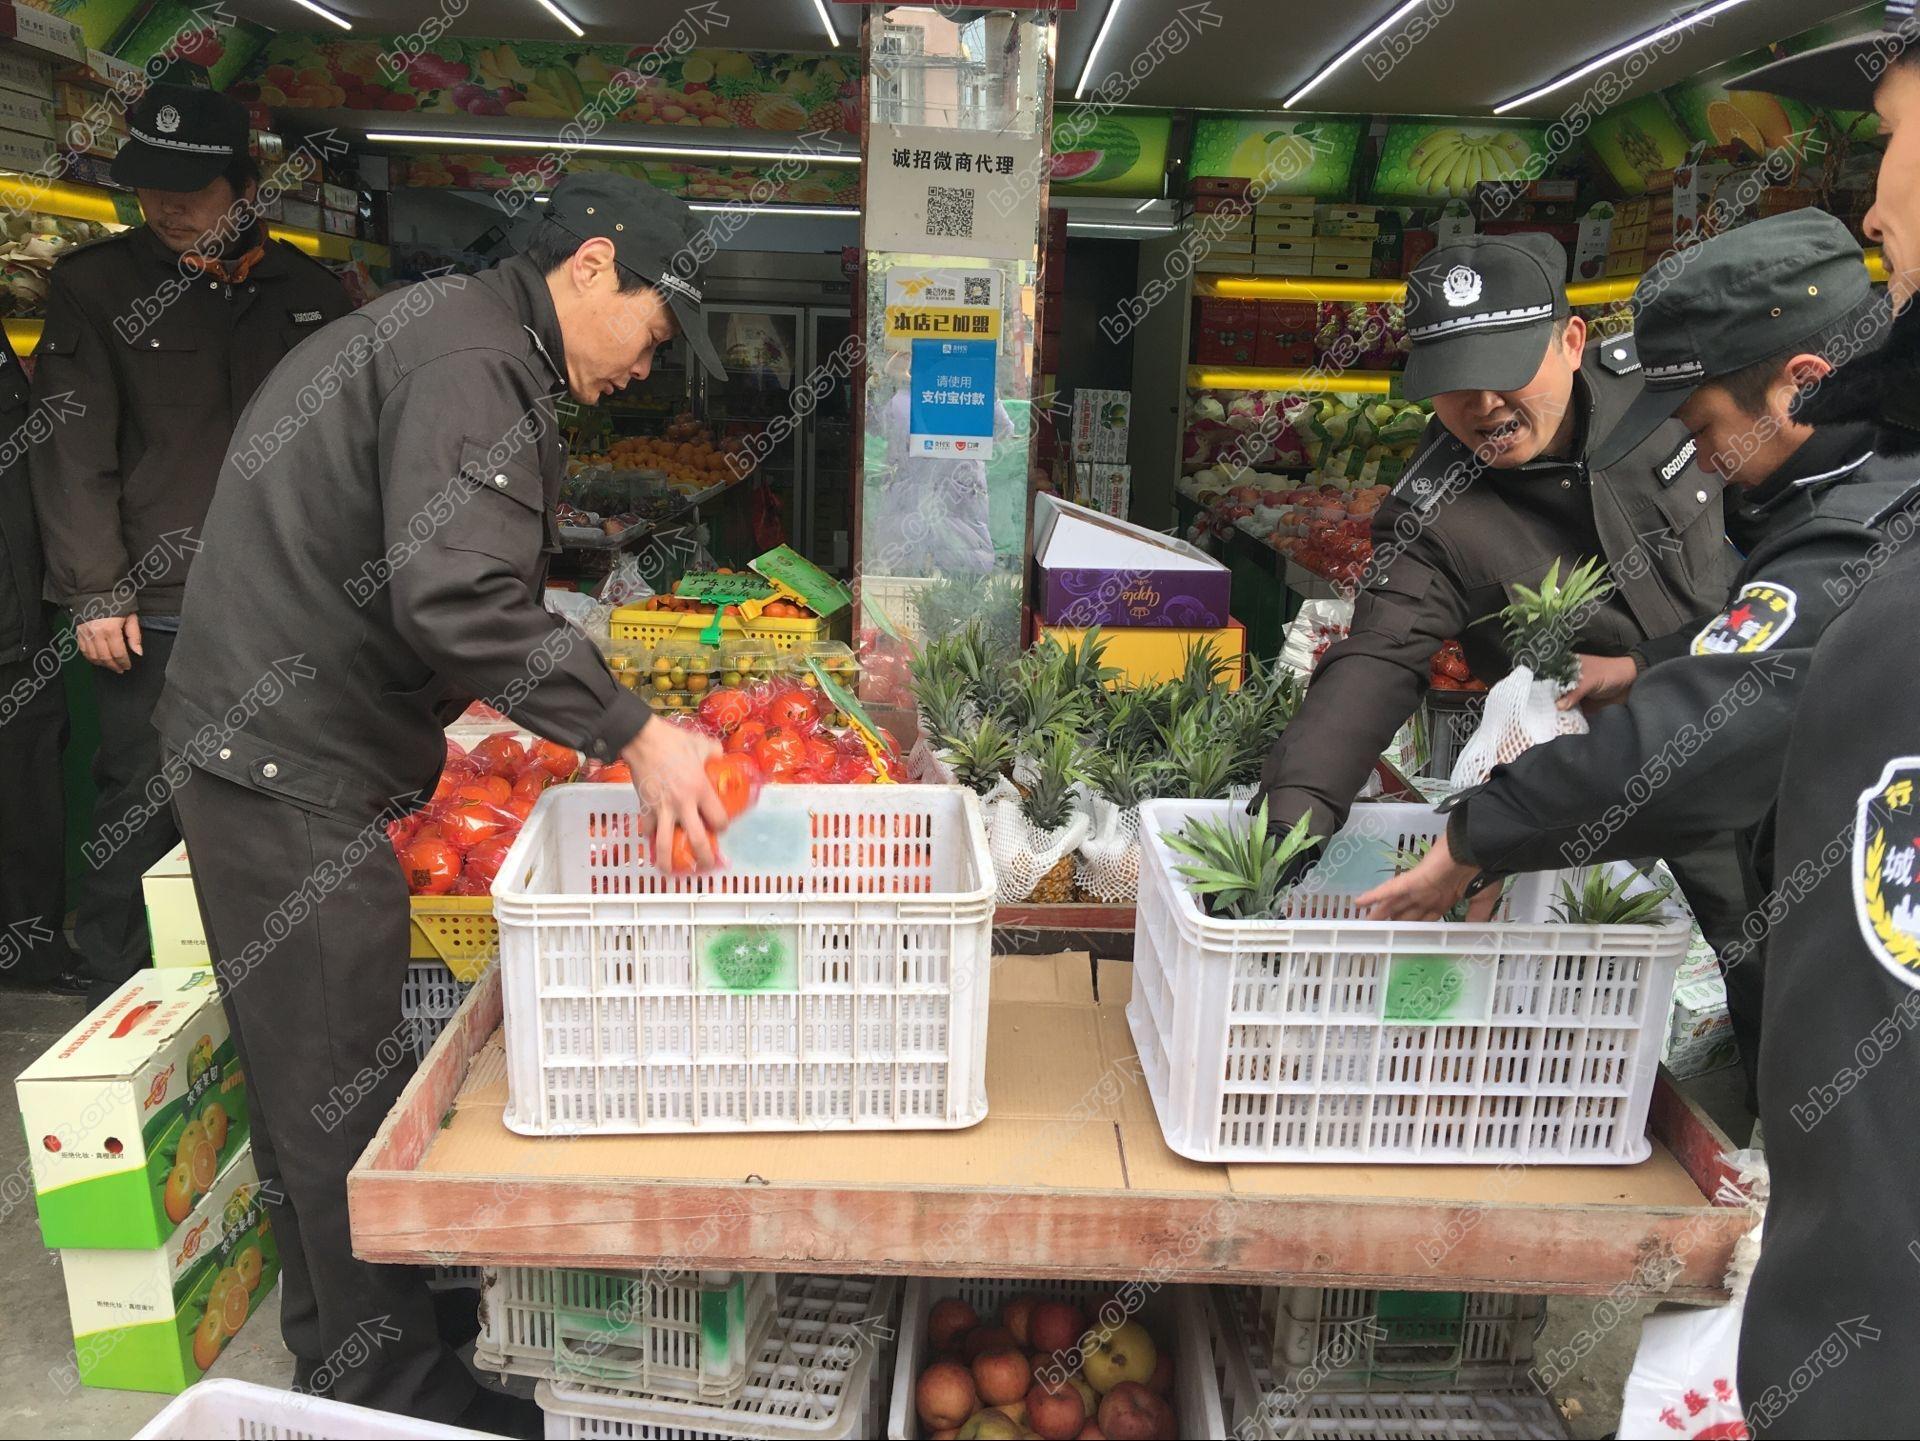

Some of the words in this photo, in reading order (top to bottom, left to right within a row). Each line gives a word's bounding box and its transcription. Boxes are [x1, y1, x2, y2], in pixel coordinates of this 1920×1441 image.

[892, 148, 1014, 175] 诚招微商代理
[893, 312, 990, 333] 本店已加盟
[936, 375, 972, 389] 请使用
[921, 390, 985, 406] 支付宝付款
[1882, 844, 1915, 888] 城
